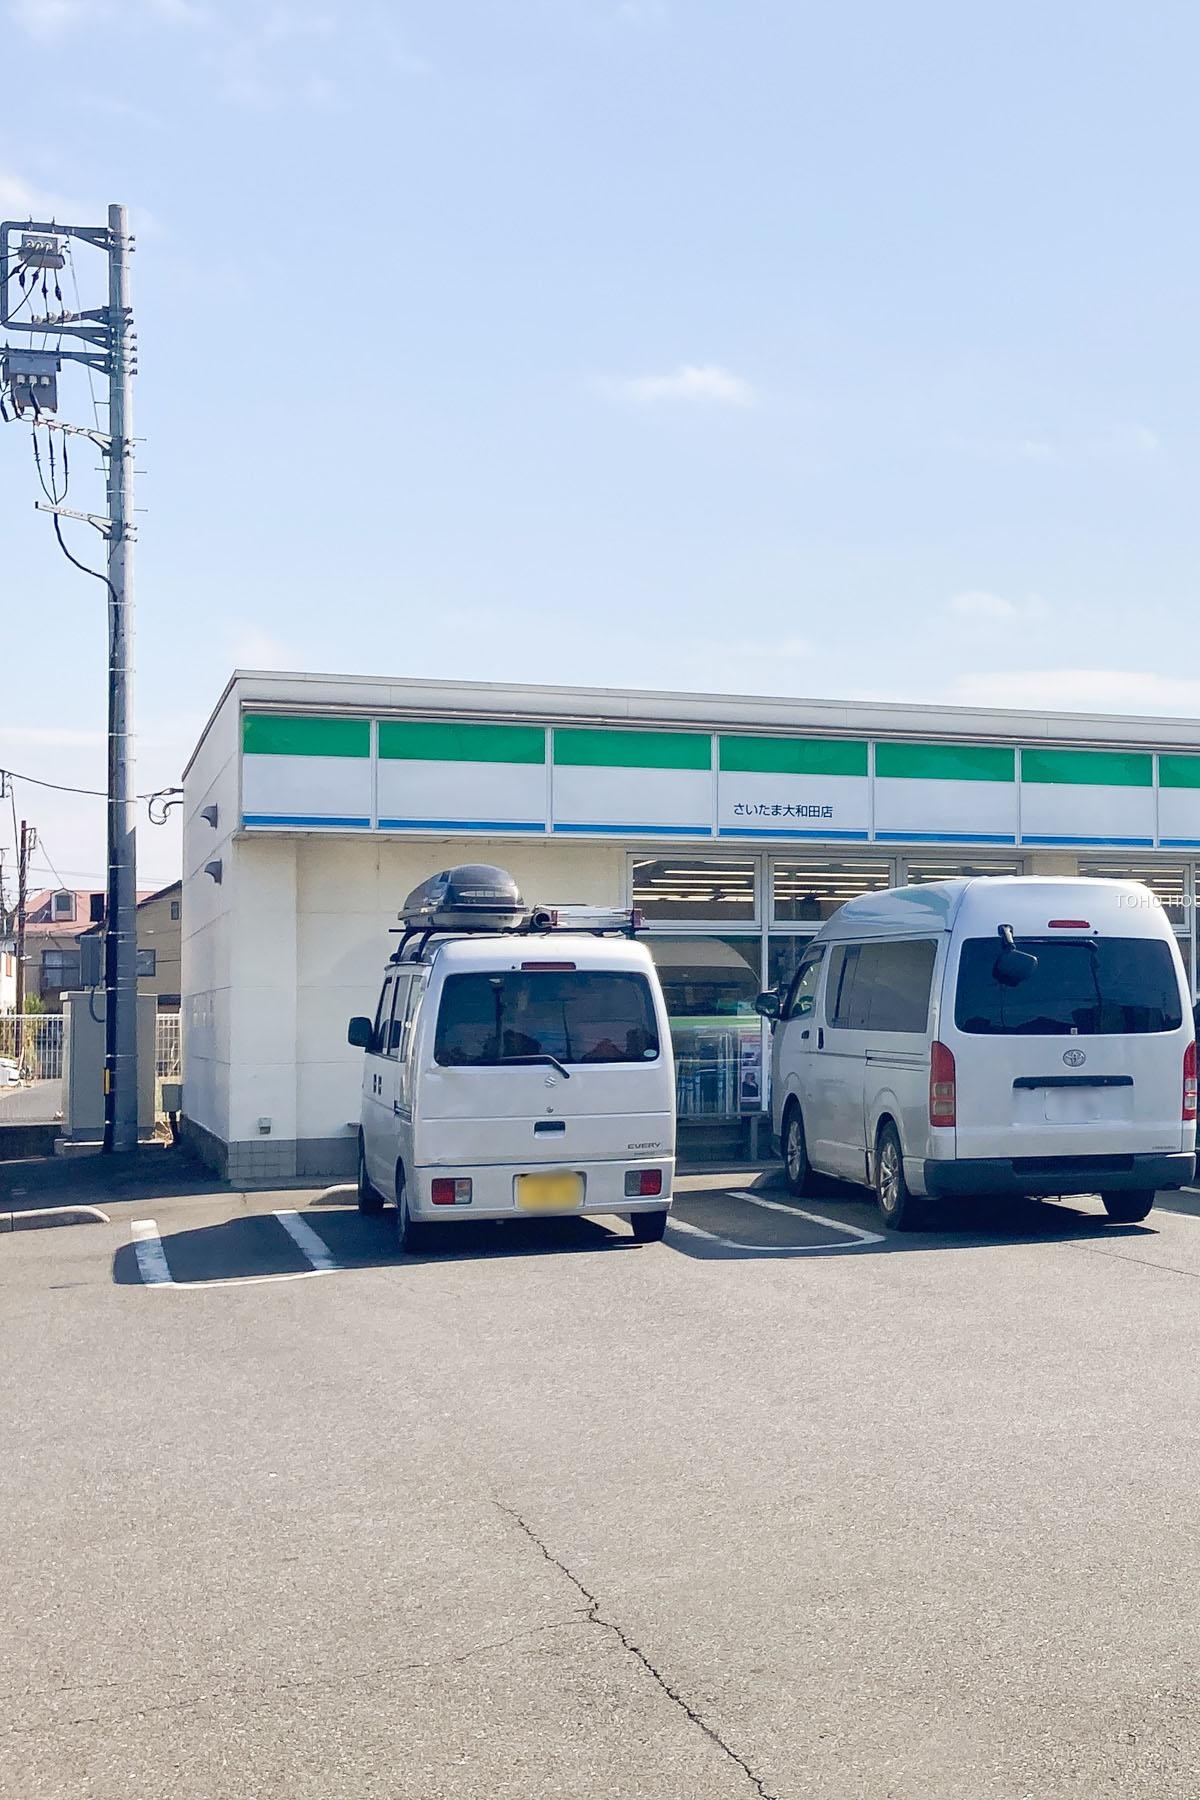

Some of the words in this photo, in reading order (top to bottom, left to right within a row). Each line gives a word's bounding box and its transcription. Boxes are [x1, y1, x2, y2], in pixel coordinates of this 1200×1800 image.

[733, 803, 833, 818] さいたま大和田店
[627, 1142, 661, 1150] EVERY
